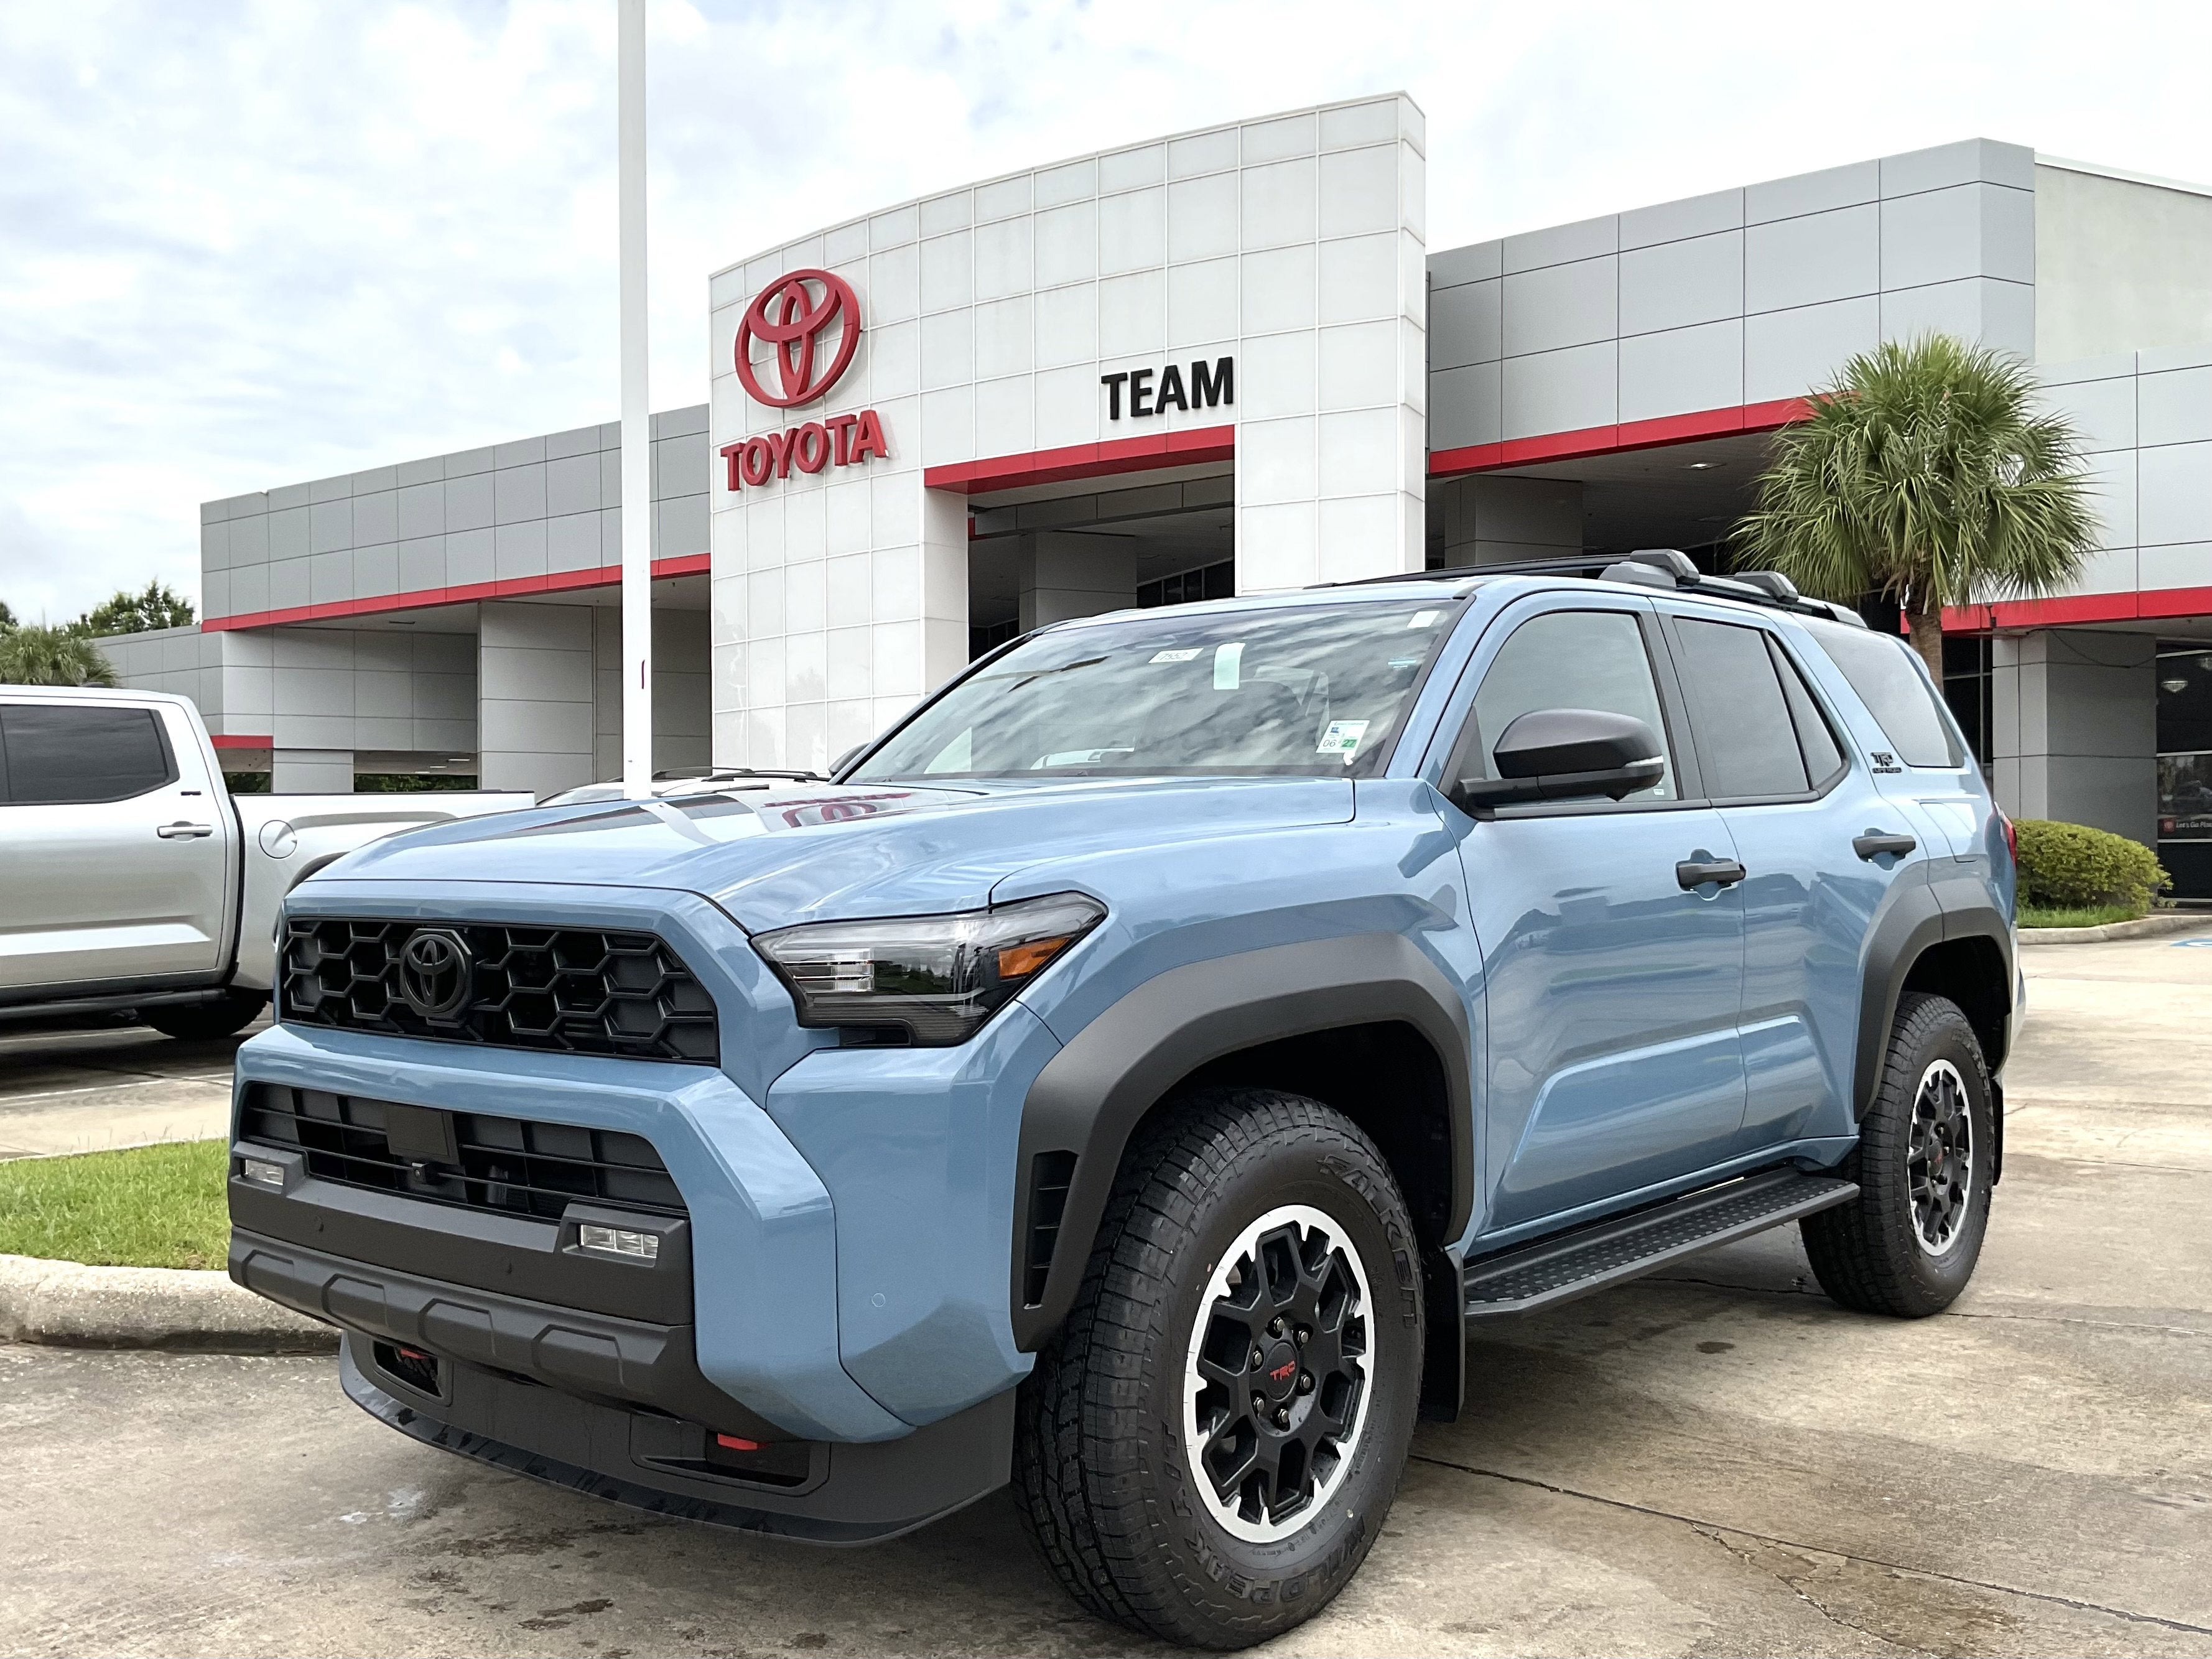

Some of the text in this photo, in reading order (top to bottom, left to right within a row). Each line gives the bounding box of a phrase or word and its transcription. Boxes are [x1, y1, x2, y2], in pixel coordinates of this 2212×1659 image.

[1101, 356, 1233, 420] TEAM
[720, 409, 888, 491] TOYOTA
[1322, 739, 1357, 747] 06 27
[1316, 1153, 1418, 1329] FALKEN
[1270, 1360, 1296, 1381] TRD
